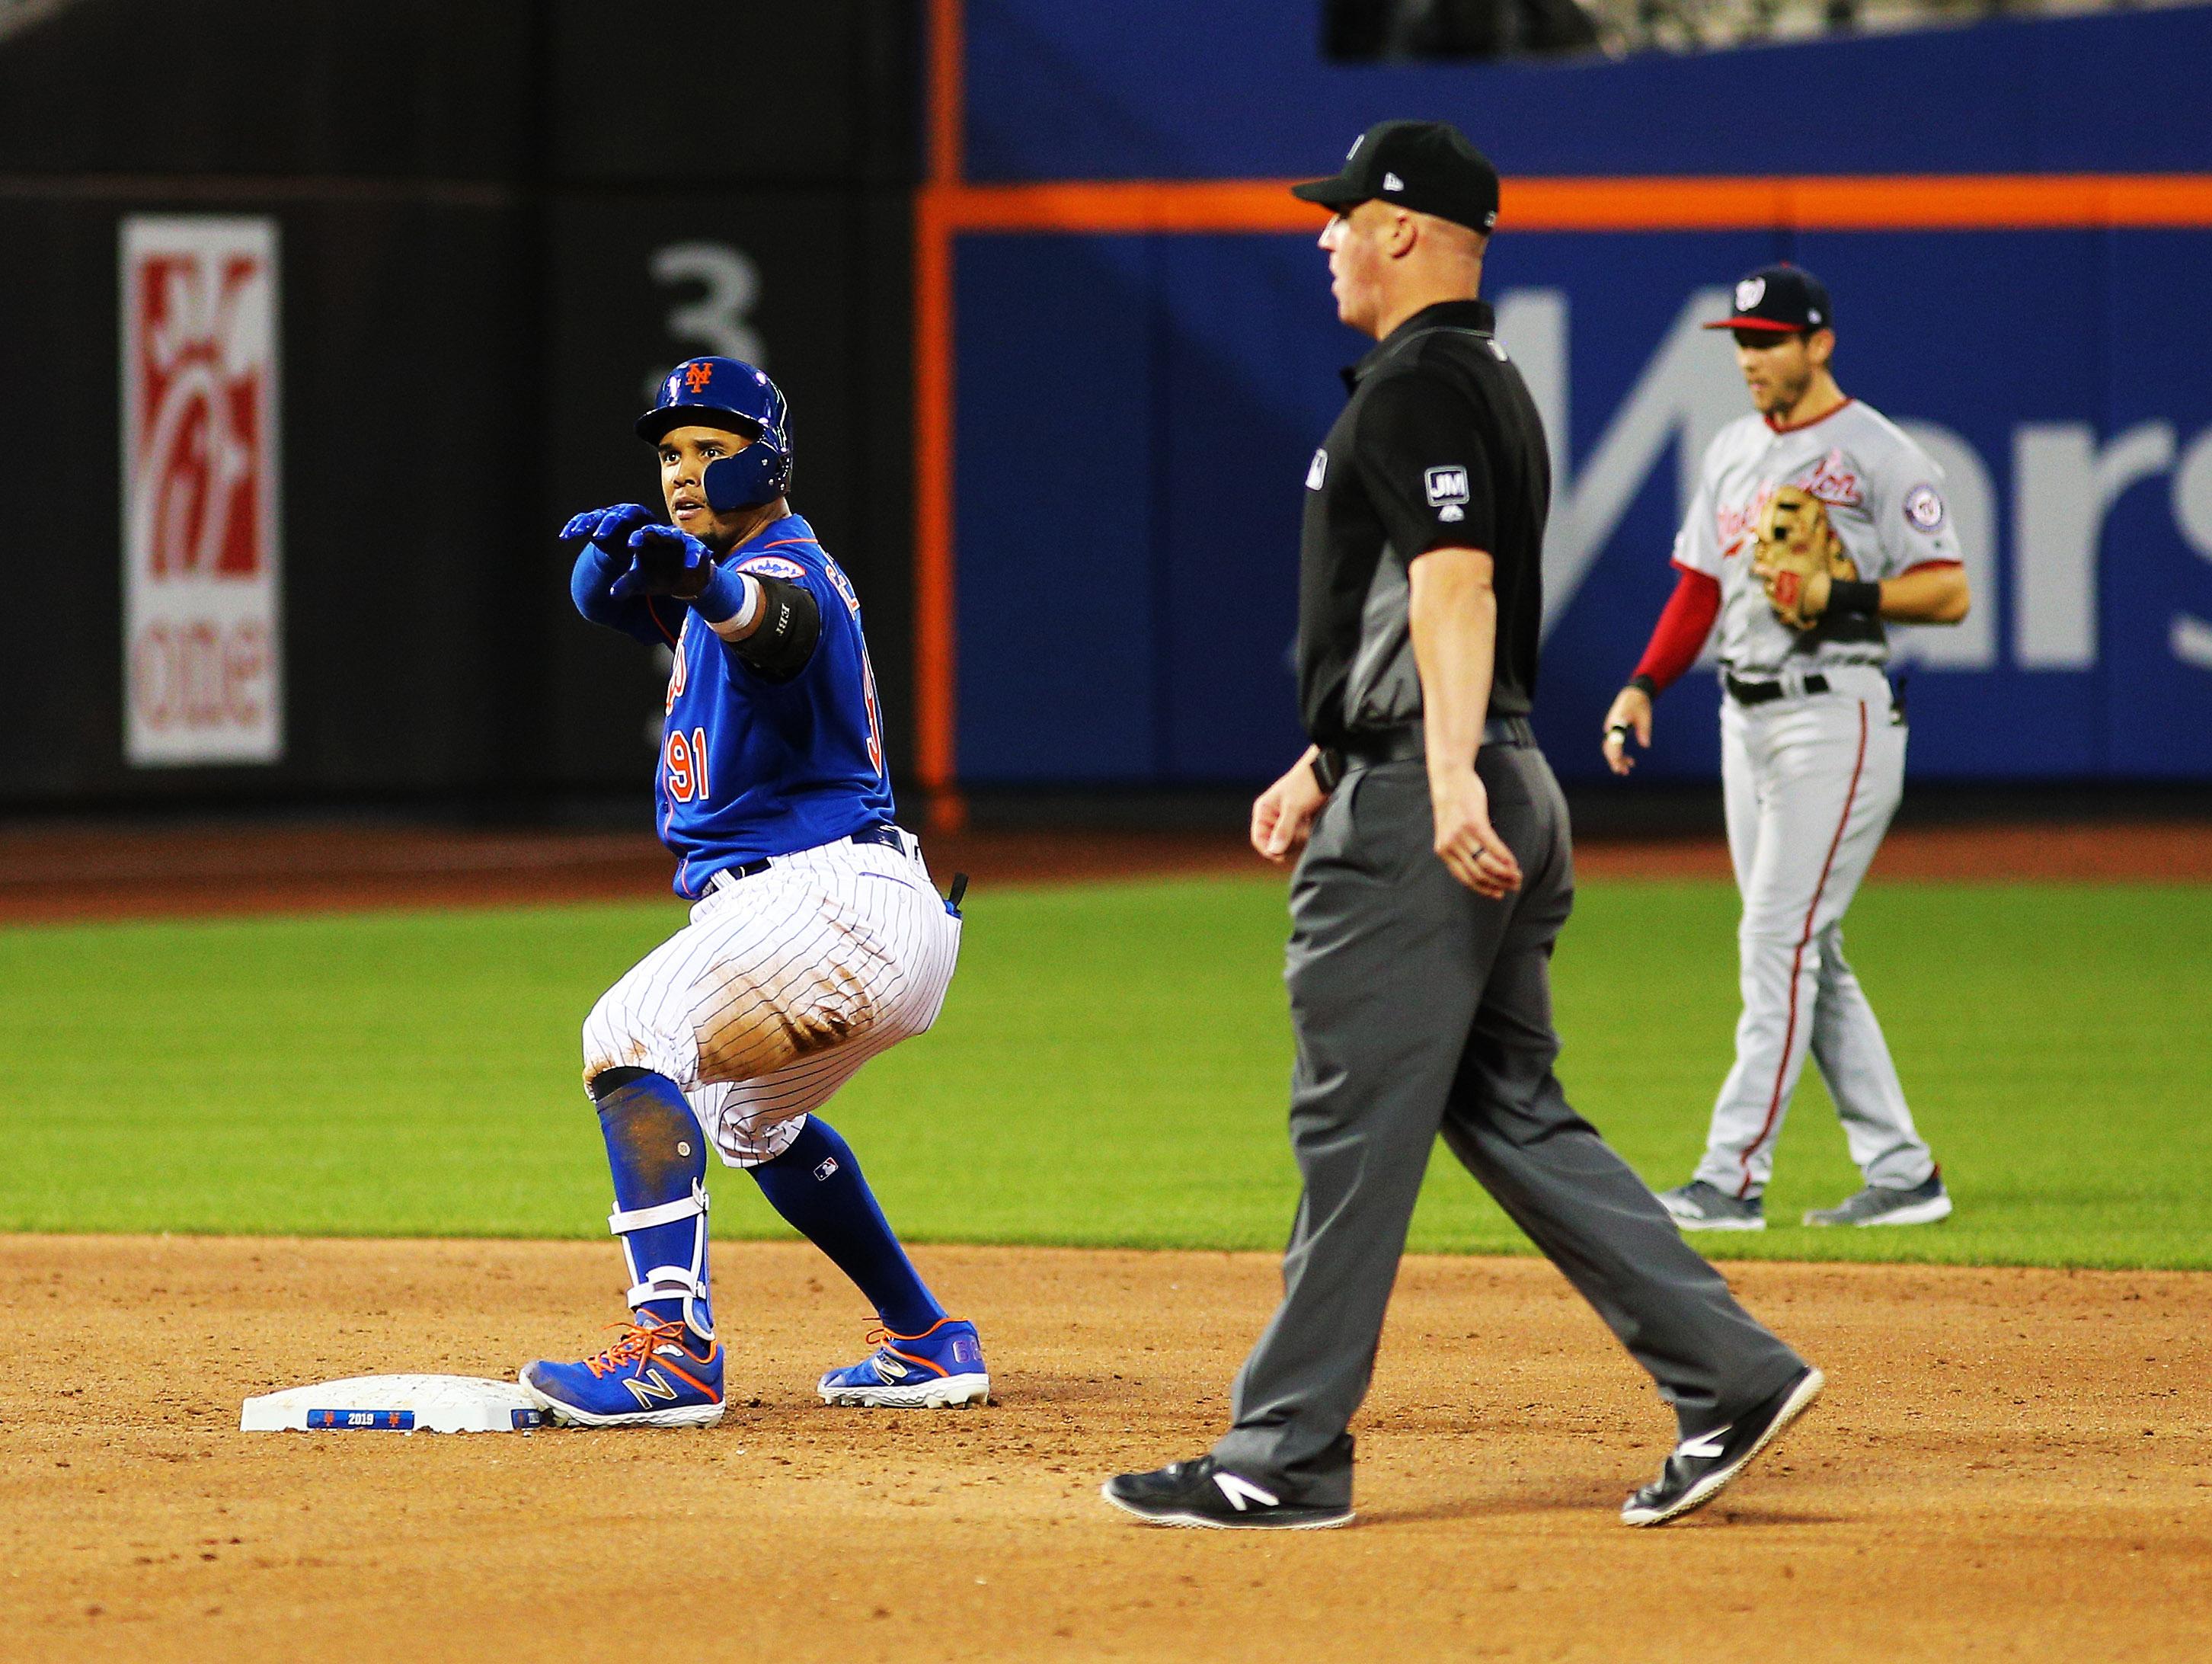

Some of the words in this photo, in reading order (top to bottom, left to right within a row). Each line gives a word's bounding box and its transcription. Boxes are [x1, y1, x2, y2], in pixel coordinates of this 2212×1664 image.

[1431, 472, 1464, 498] JM
[666, 727, 709, 803] 91
[347, 1413, 374, 1426] 2019
